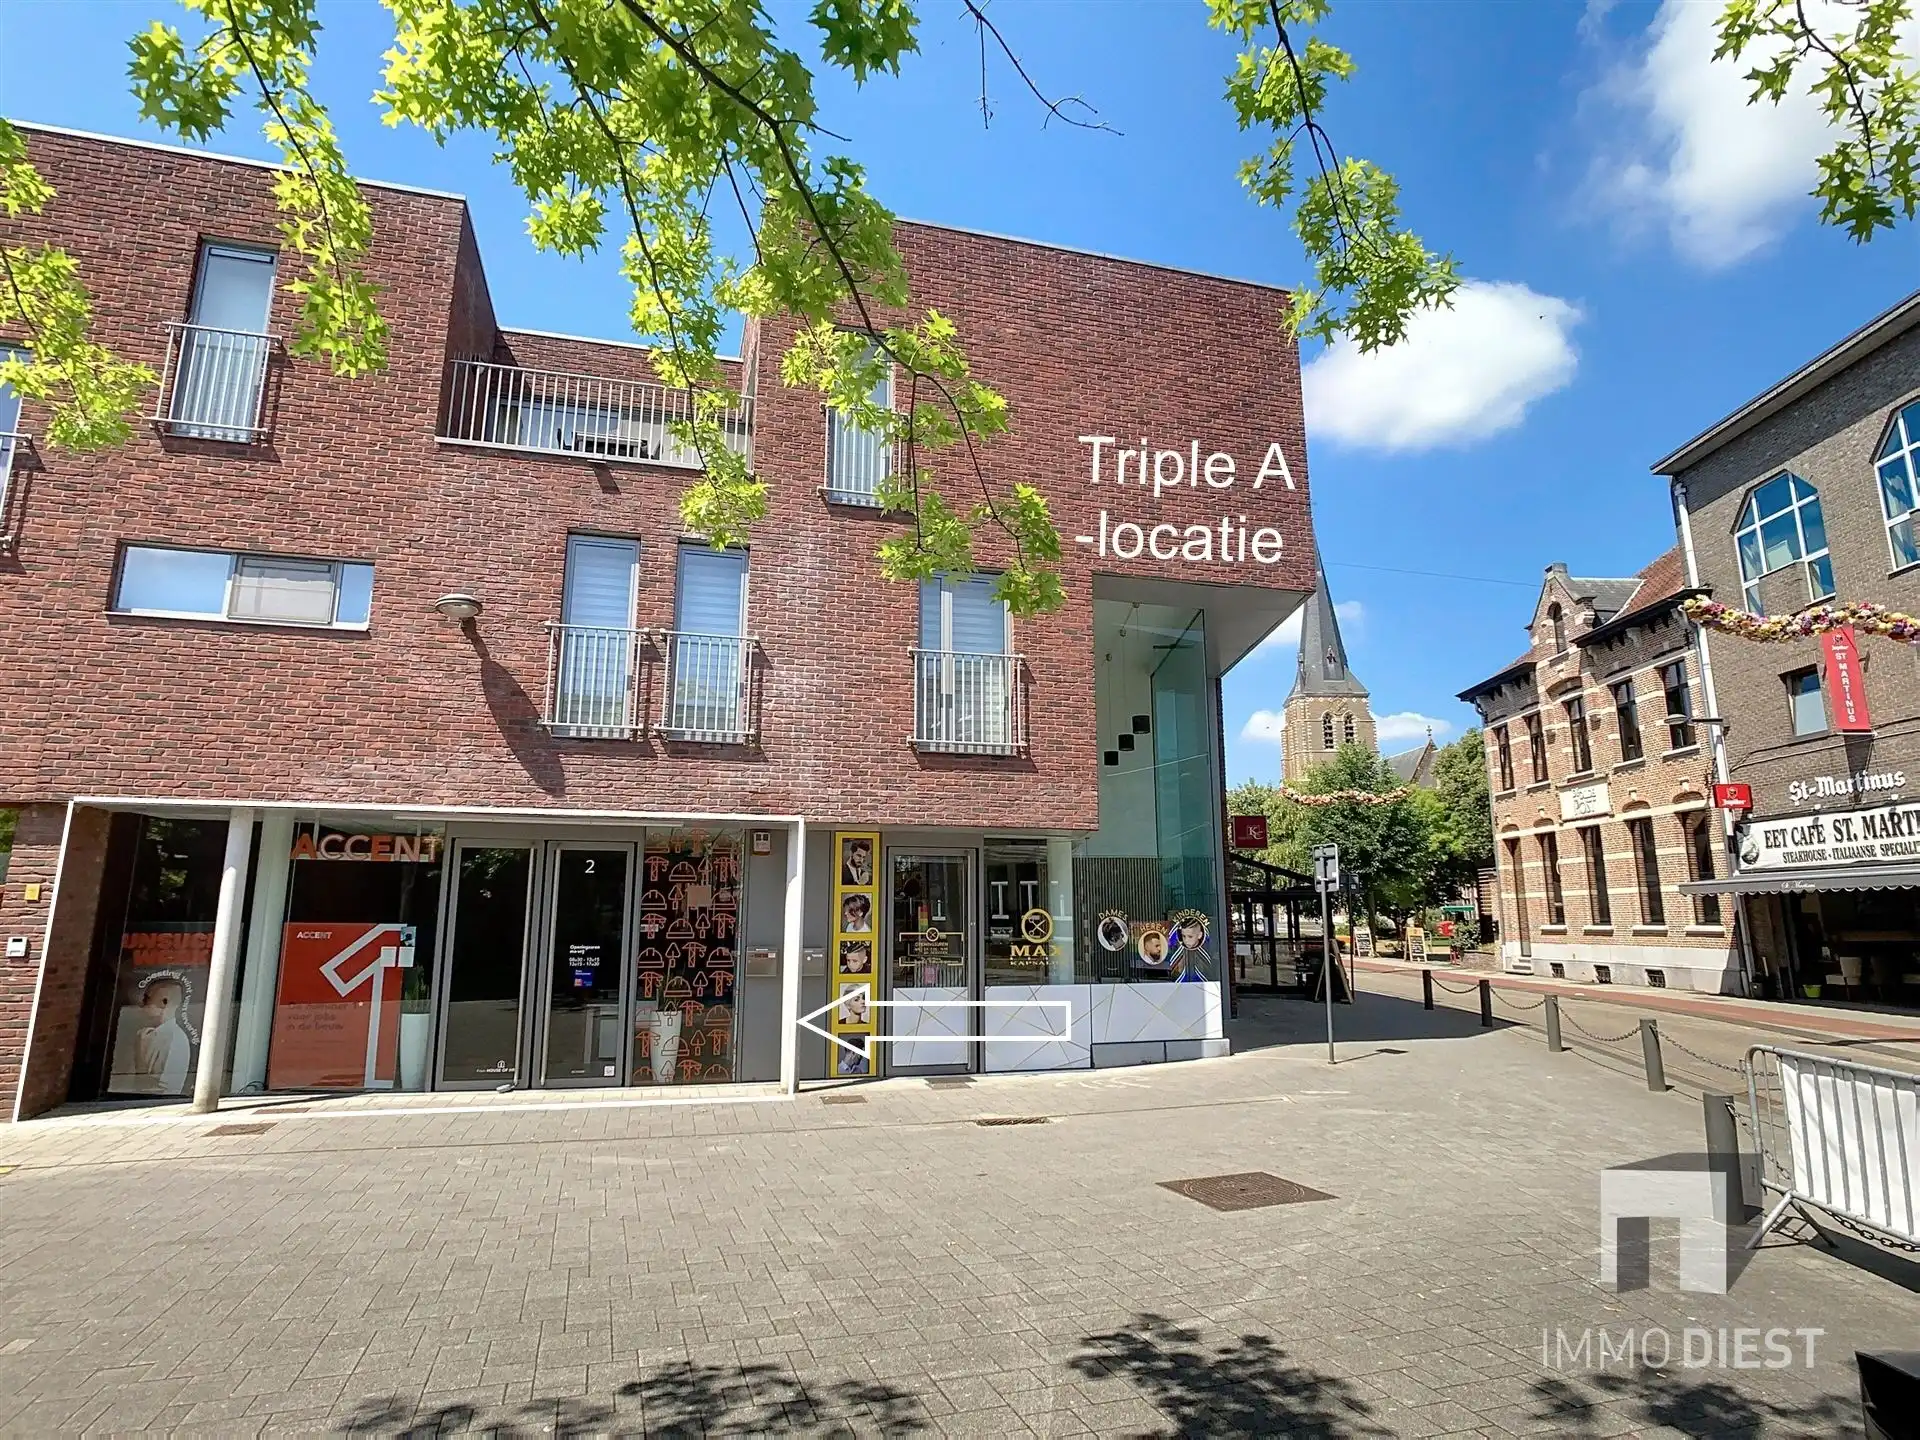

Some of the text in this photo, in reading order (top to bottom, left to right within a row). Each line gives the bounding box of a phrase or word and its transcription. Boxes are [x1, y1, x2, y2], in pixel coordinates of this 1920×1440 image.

[1838, 662, 1857, 723] MARTINUS
[1763, 829, 1789, 849] EET
[1832, 817, 1858, 843] ST.
[290, 833, 440, 863] ACCENT
[1782, 848, 1828, 864] STEAKHOUSE
[1831, 844, 1877, 860] ITALIAANSE
[585, 860, 595, 874] 2
[1098, 909, 1128, 921] DAMES
[1172, 908, 1210, 926] KINDEREN
[296, 931, 333, 940] ACCENT
[1140, 922, 1168, 934] HEREN
[138, 969, 182, 989] Goesting
